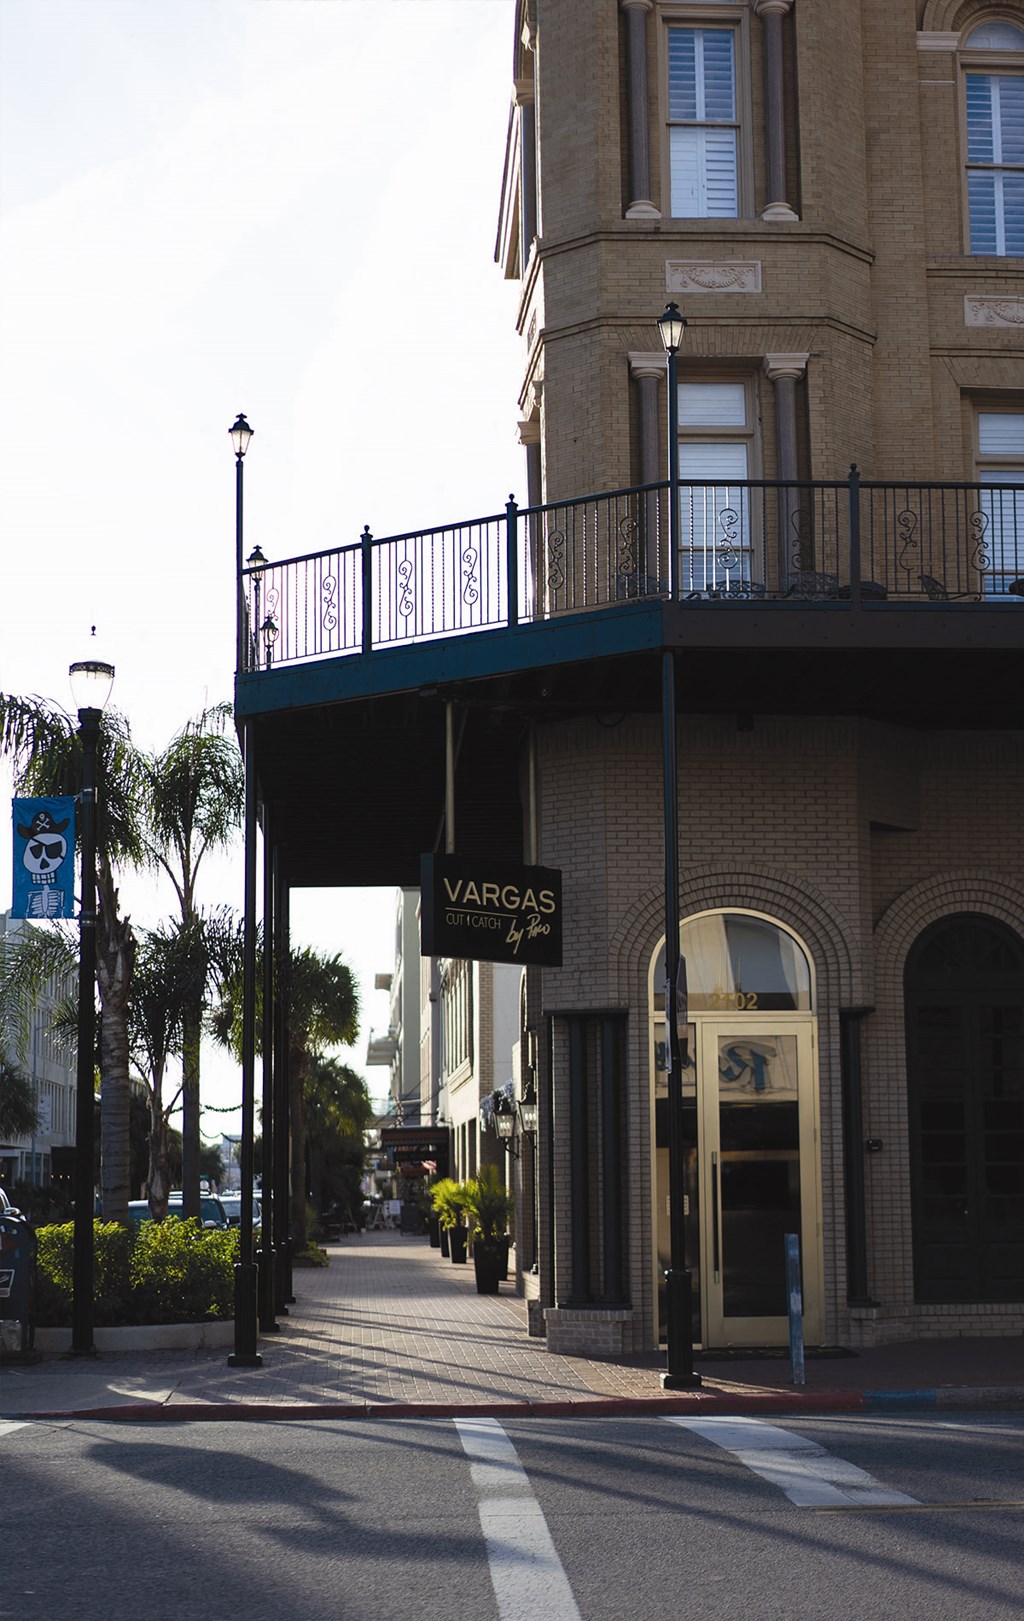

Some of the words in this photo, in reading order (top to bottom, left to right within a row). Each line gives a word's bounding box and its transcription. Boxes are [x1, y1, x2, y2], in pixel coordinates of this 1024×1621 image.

[442, 877, 557, 914] VARGAS
[446, 913, 465, 925] CUT
[471, 915, 501, 929] CATCH
[505, 919, 524, 955] by
[710, 992, 758, 1010] 2102
